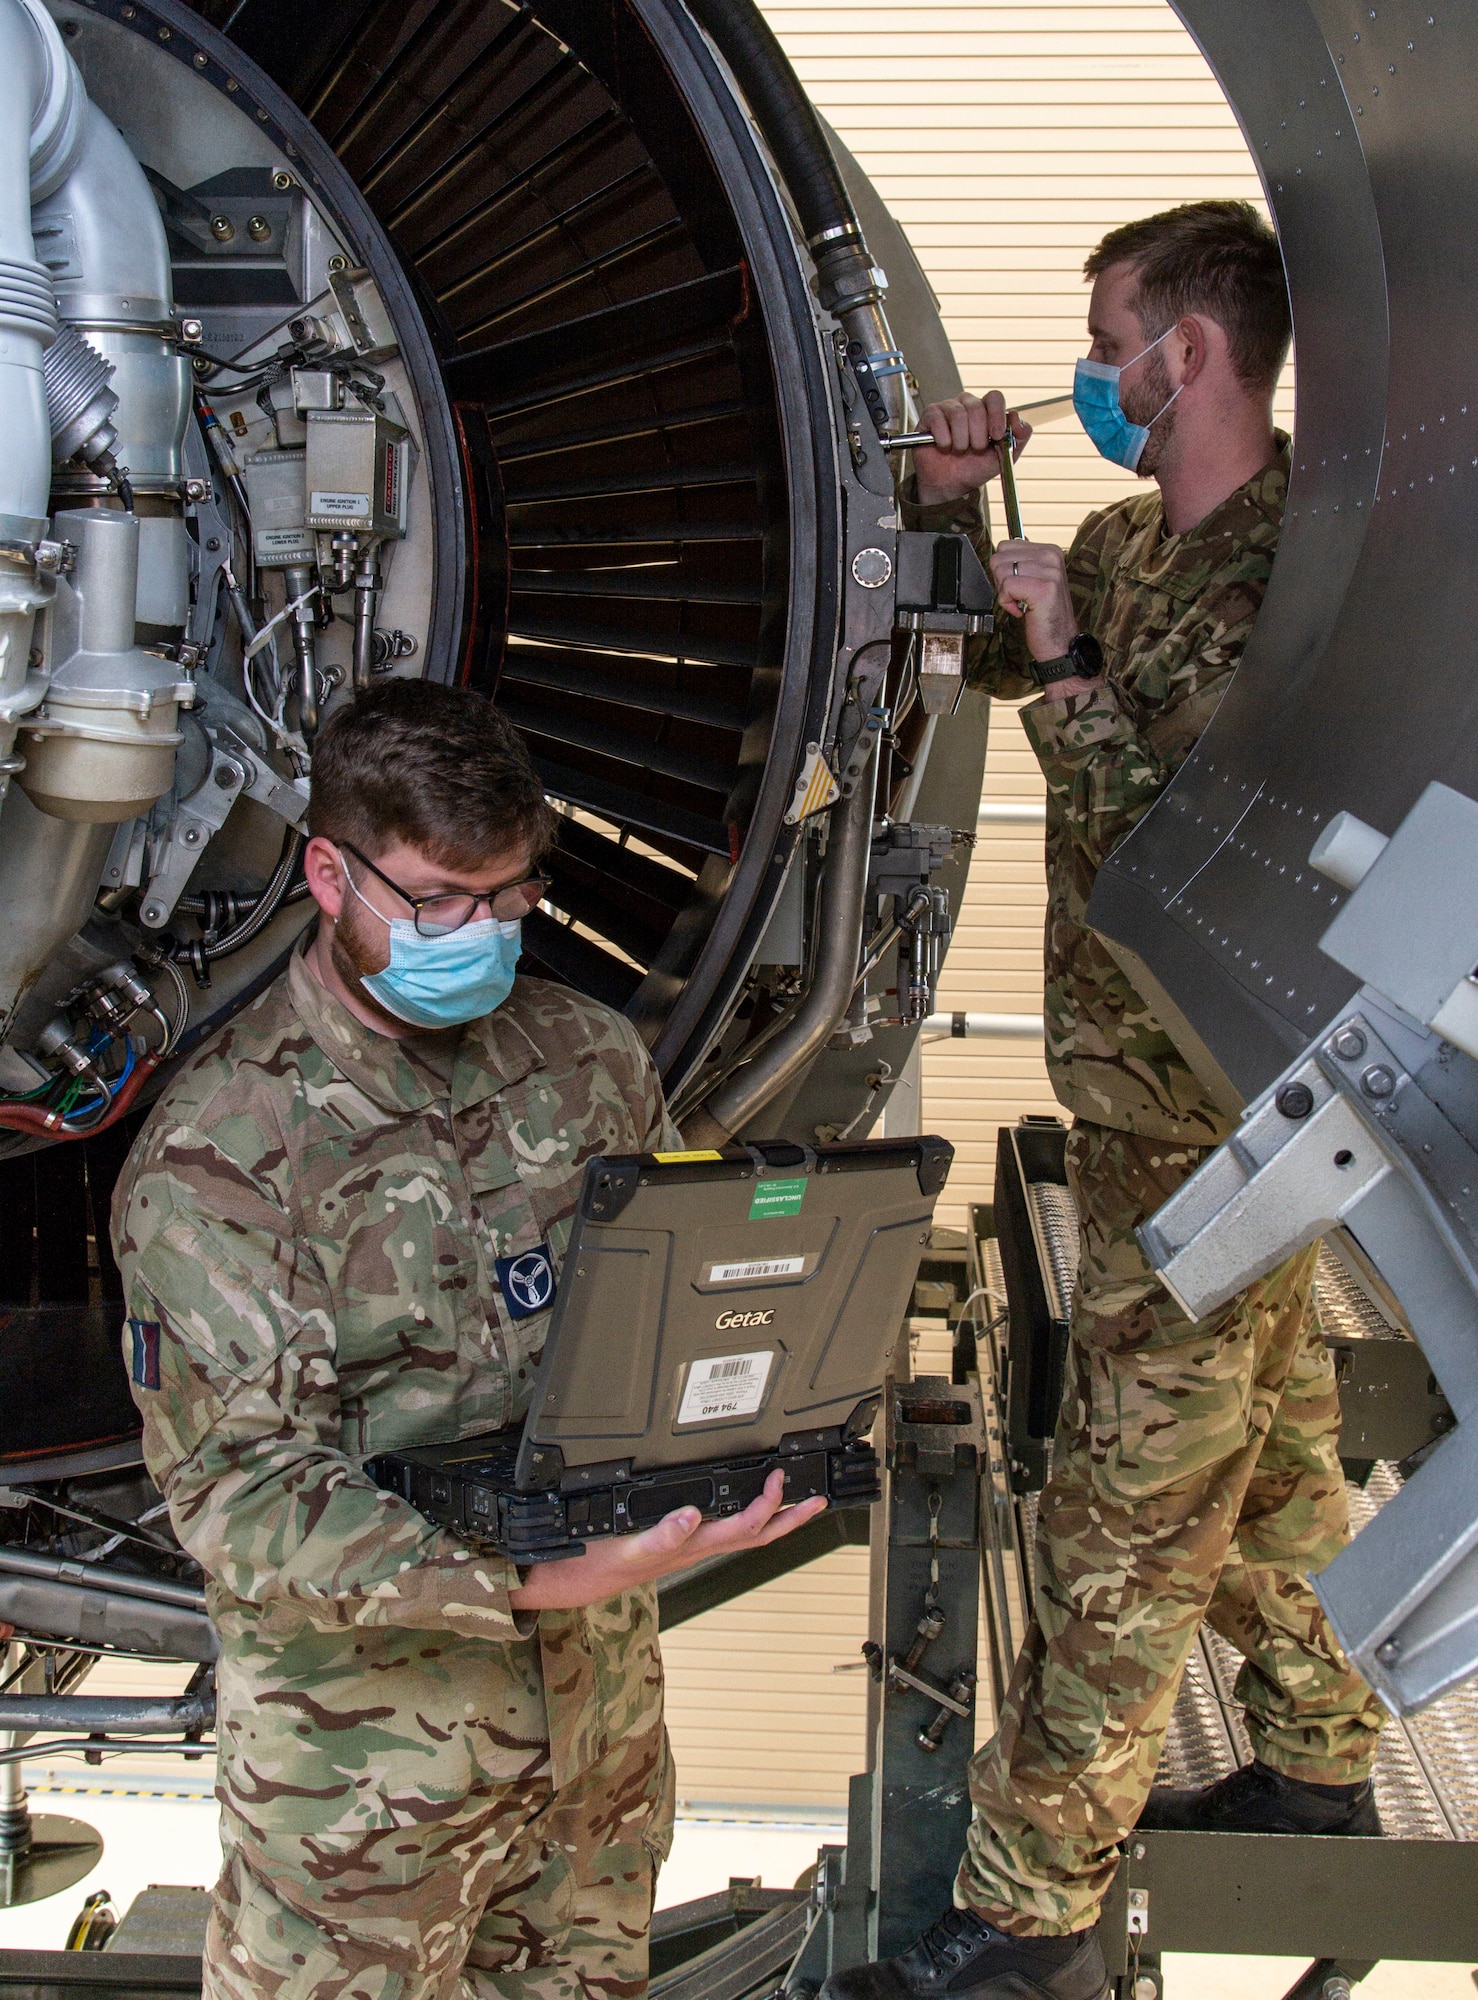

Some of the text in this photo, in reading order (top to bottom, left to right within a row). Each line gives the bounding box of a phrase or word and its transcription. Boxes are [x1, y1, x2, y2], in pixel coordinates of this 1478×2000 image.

[754, 1194, 801, 1204] UNCLASSIFIED
[715, 1310, 775, 1330] Getac
[702, 1402, 738, 1415] 794 #40
